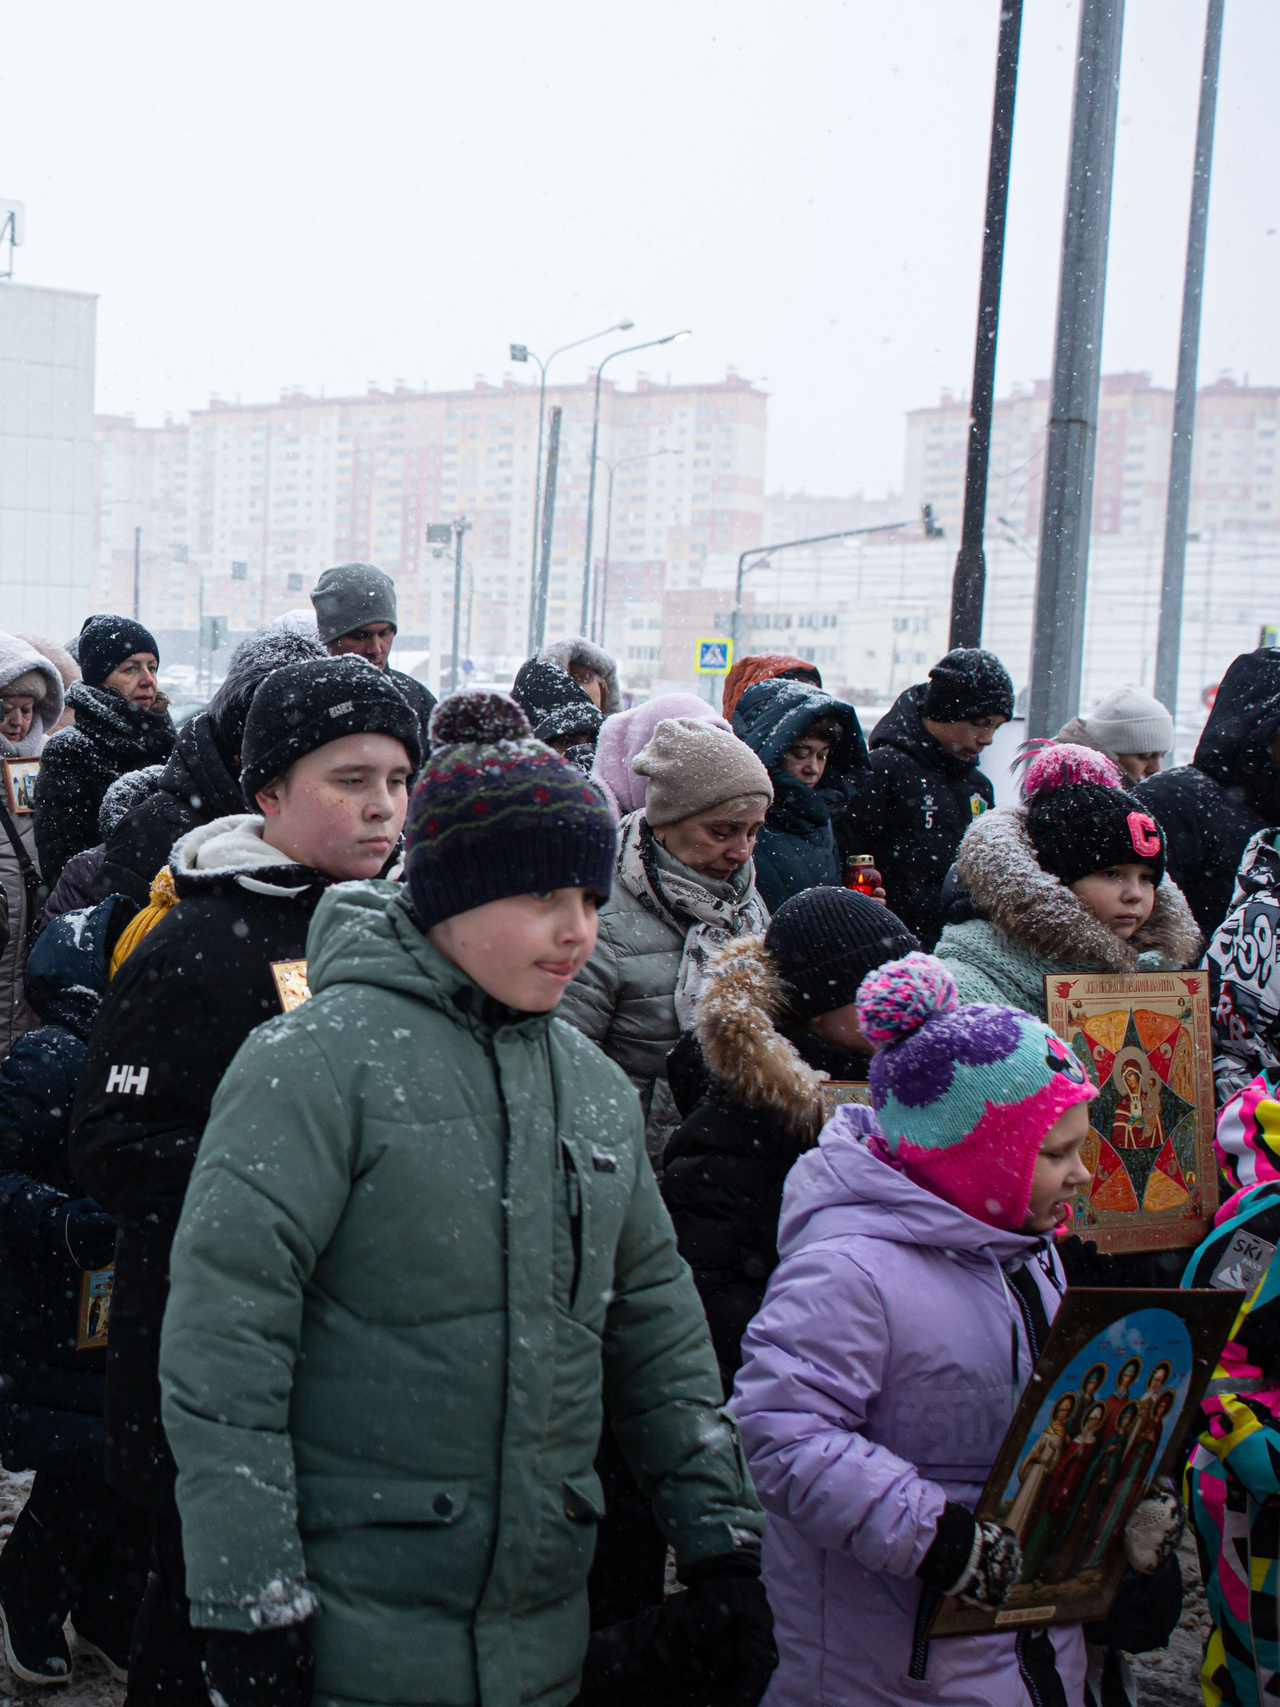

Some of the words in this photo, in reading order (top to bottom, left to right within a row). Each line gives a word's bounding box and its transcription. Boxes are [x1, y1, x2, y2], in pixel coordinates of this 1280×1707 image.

[924, 811, 934, 829] 5
[1126, 811, 1161, 857] C
[105, 1064, 150, 1096] HH
[1232, 1238, 1263, 1262] SKI
[1241, 1257, 1263, 1272] PASS
